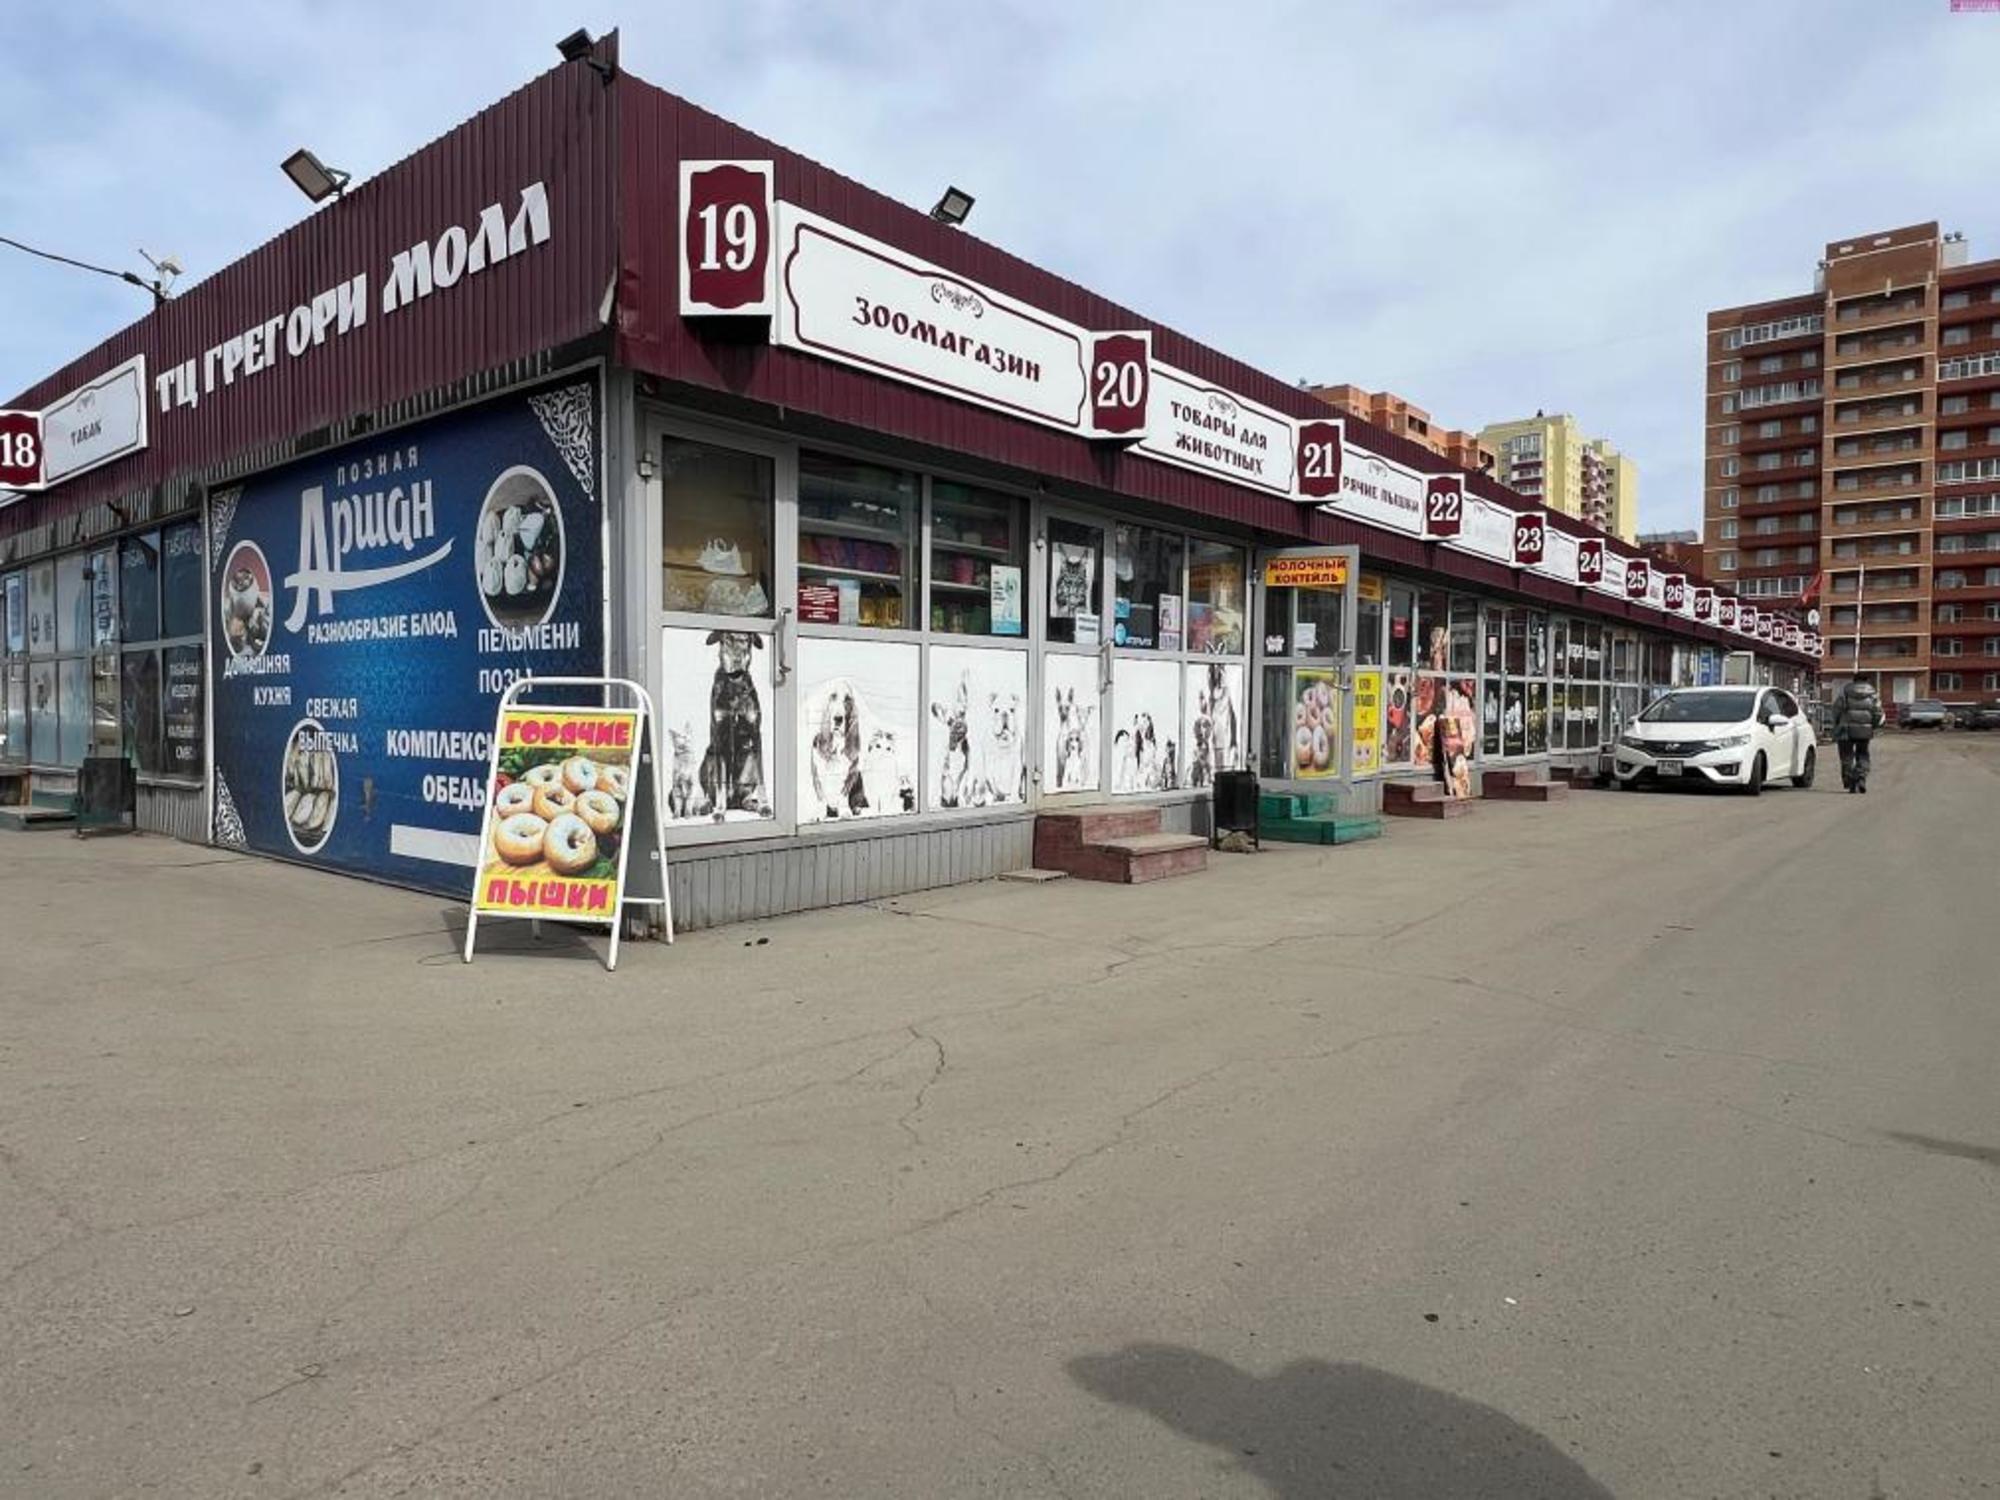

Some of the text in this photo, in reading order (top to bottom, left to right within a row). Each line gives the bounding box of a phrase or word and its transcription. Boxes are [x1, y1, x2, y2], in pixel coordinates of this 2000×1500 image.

[699, 203, 757, 272] 19
[156, 182, 551, 412] ТЦ ГРЕГОРИ МОЛЛ
[1097, 361, 1143, 409] 20
[1171, 401, 1267, 450] ТОВАРЫ ДЛЯ
[0, 432, 36, 467] 18
[1176, 431, 1263, 475] ЖИВОТНЫХ
[1304, 443, 1334, 478] 21
[338, 446, 418, 487] ПОЗНАЯ
[1343, 476, 1378, 500] РЯЧИЕ
[1430, 492, 1459, 521] 22
[1517, 527, 1542, 551] 23
[284, 477, 445, 633] Аршан
[1580, 552, 1600, 573] 24
[1275, 573, 1338, 584] КОКТЕЙЛЬ
[1627, 570, 1646, 589] 25
[1666, 585, 1683, 602] 26
[1696, 599, 1710, 613] 27
[1720, 605, 1734, 620] 28
[308, 611, 457, 644] РАЗНООБРАЗИЕ БЛЮД
[478, 621, 580, 653] ПЕЛЬМЕНИ
[254, 686, 291, 705] КУХНЯ
[306, 697, 357, 719] СВЕЖАЯ
[297, 731, 358, 753] ВЫПЕЧКА
[505, 719, 630, 746] ГОРЯЧИЕ
[486, 879, 609, 910] ПЫШКИ
